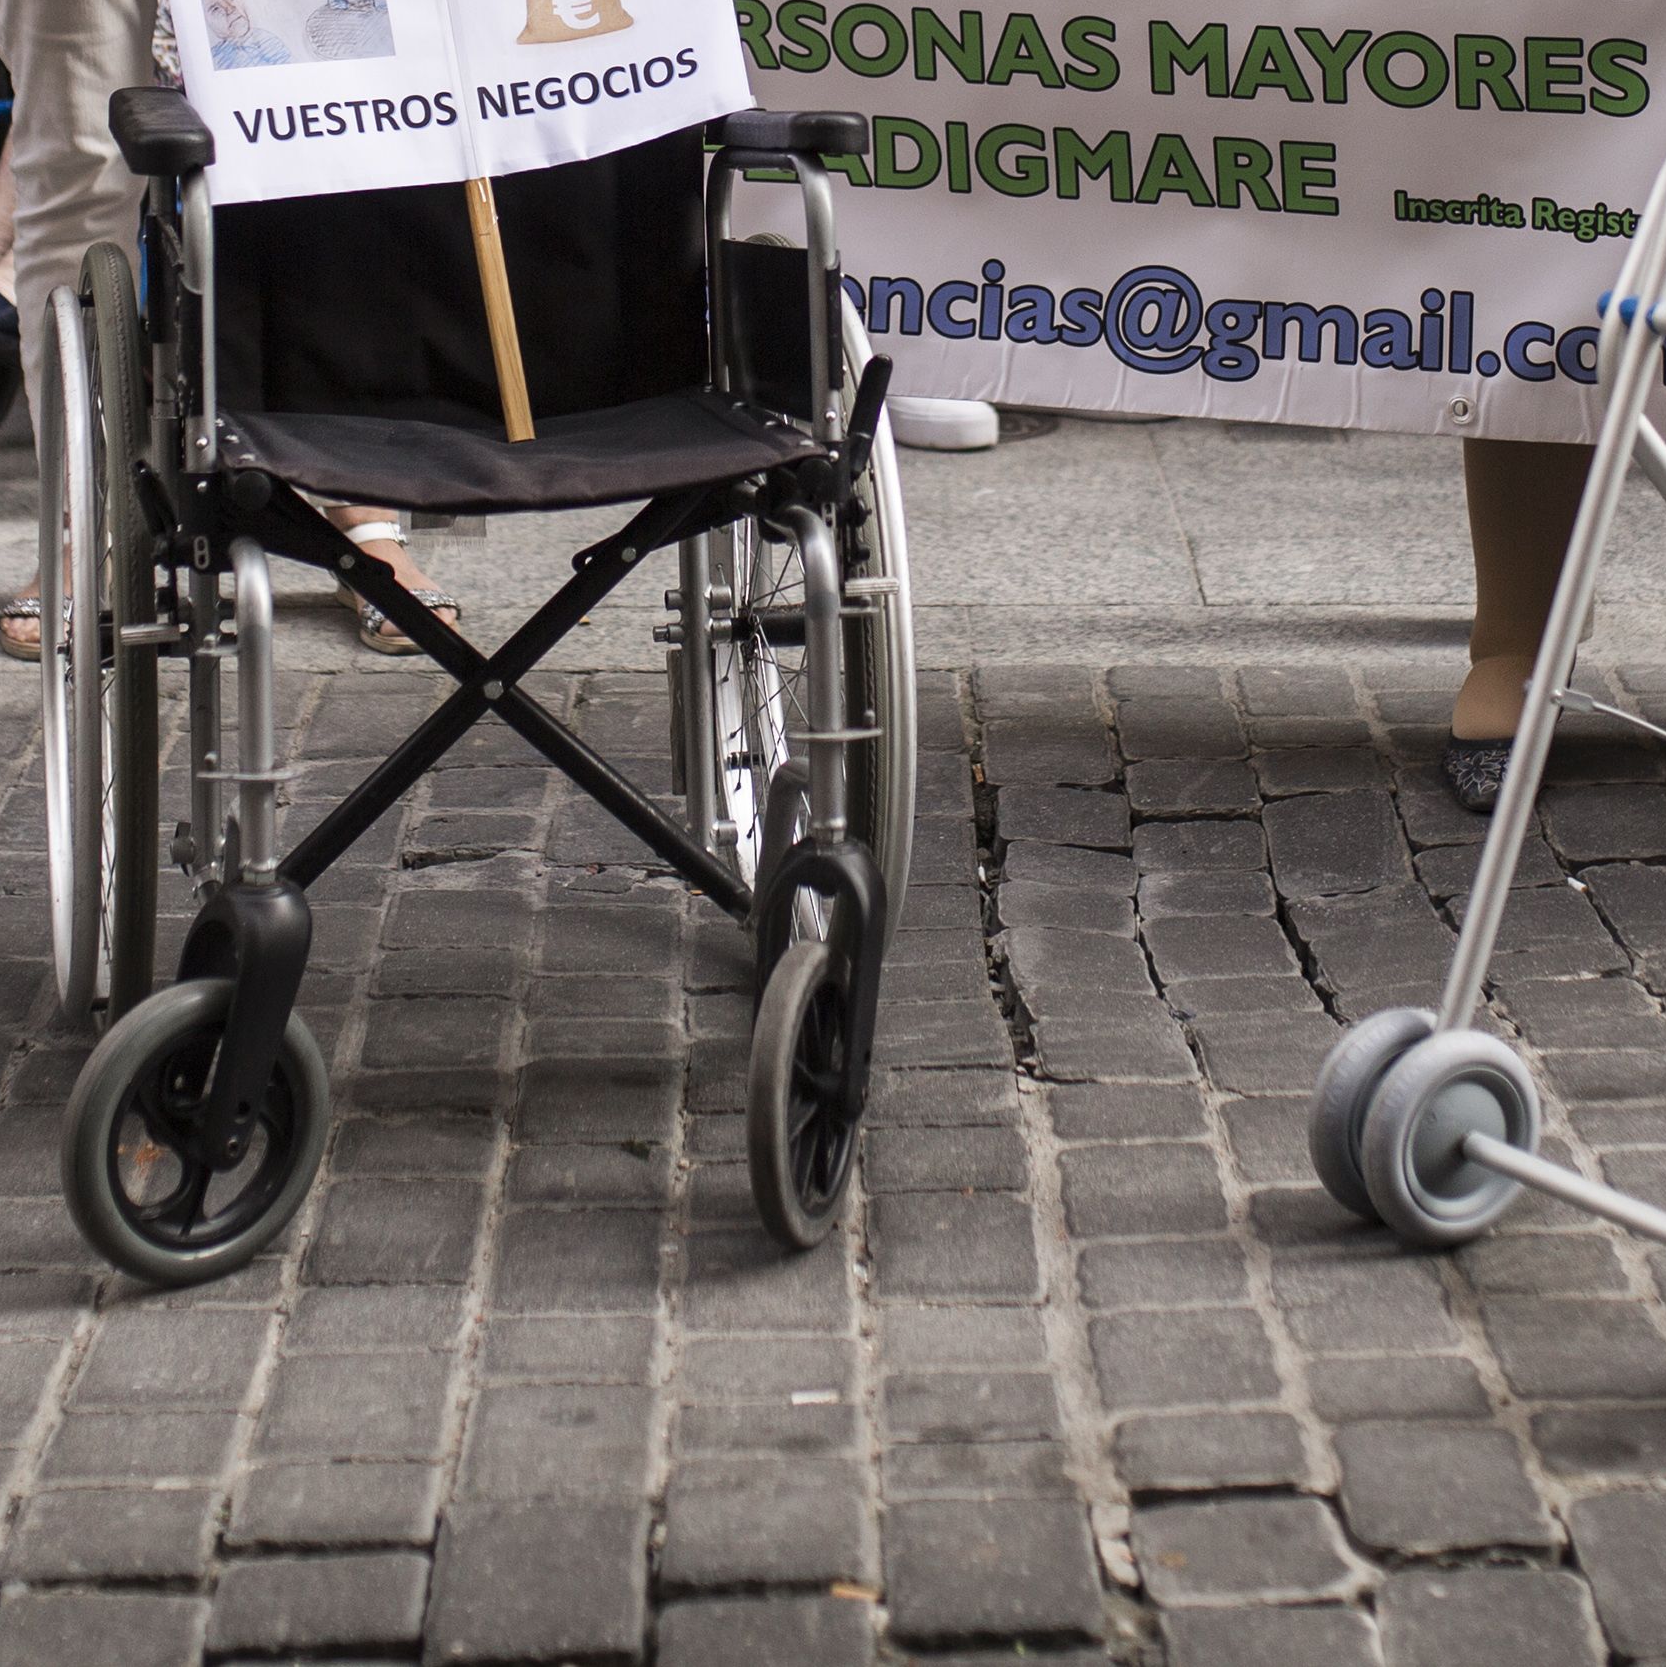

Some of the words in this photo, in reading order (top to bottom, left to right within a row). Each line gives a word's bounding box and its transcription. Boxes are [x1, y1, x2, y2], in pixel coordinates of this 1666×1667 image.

[233, 92, 458, 144] VUESTROS
[477, 48, 699, 121] NEGOCIOS
[1149, 18, 1651, 119] MAYORES
[703, 115, 1340, 217] DIGMARE
[1393, 188, 1527, 230] Inscrita
[1532, 196, 1643, 243] Regist
